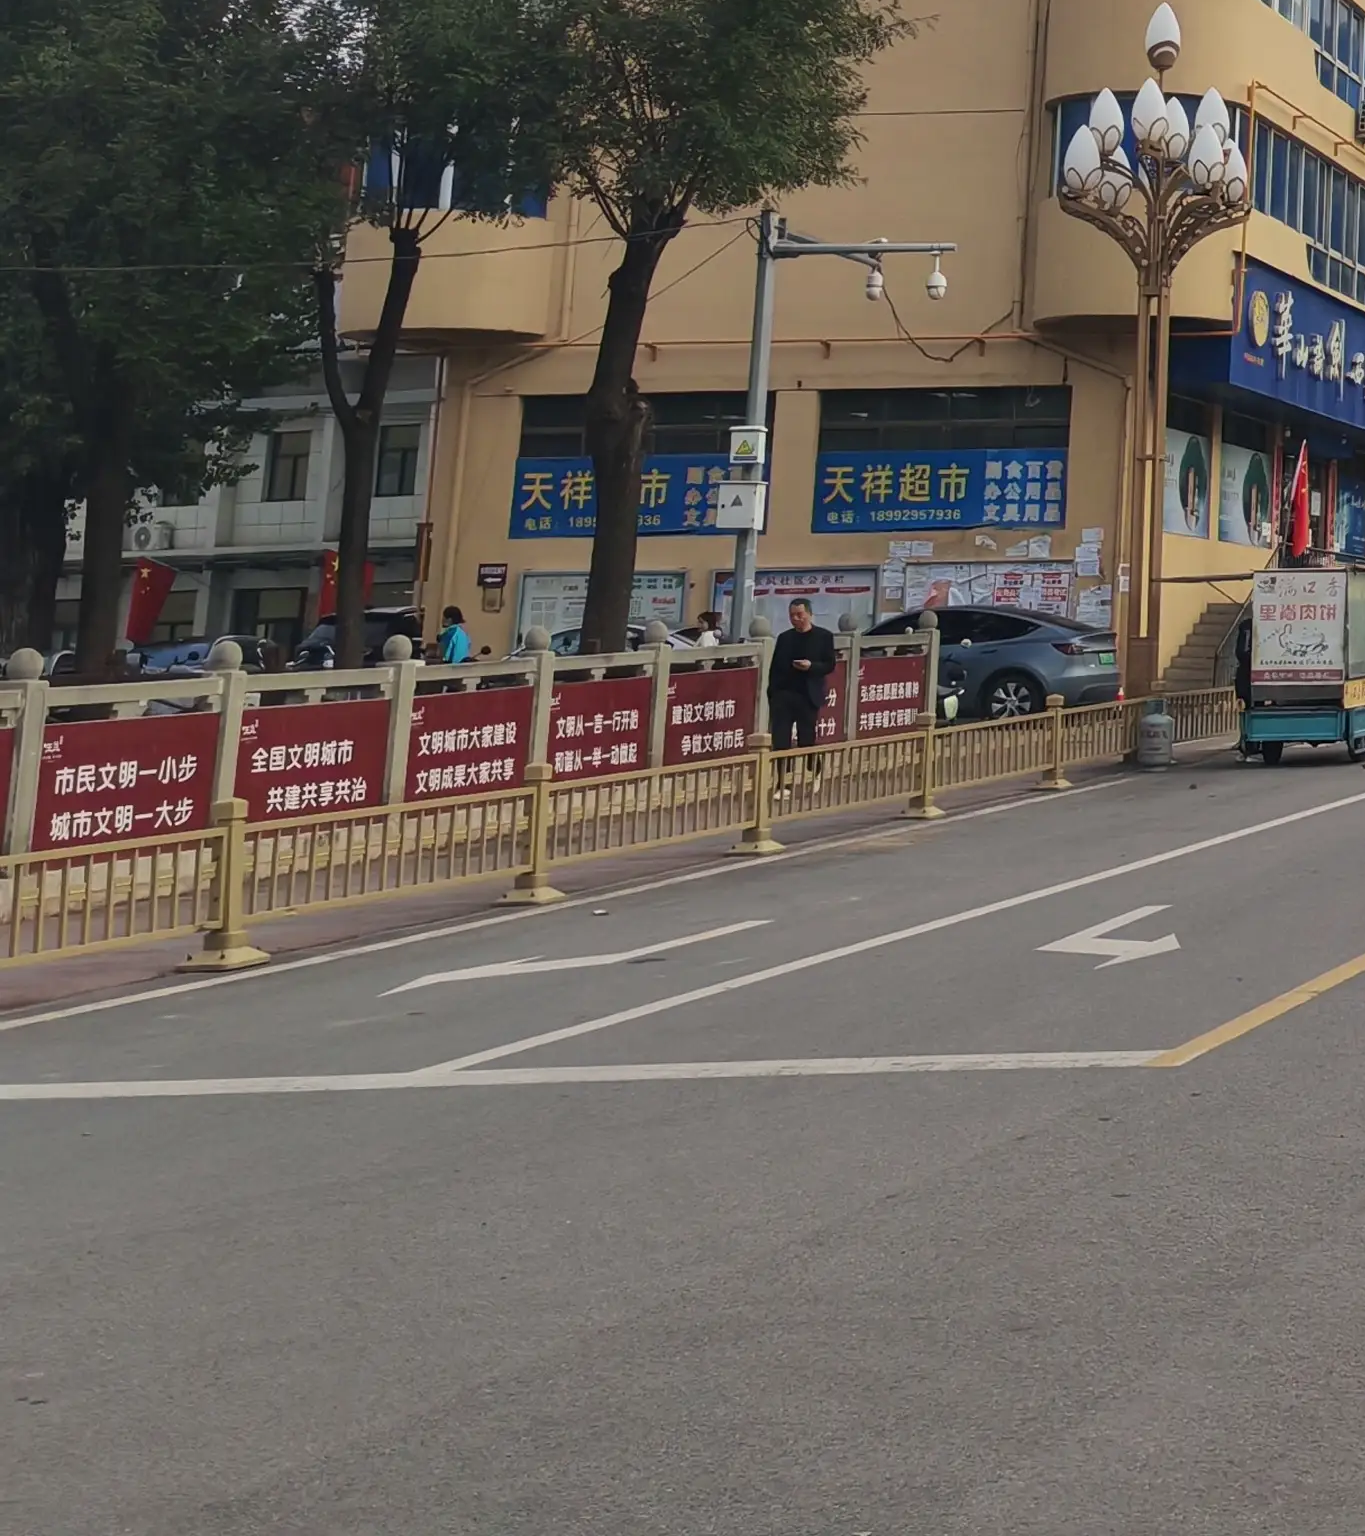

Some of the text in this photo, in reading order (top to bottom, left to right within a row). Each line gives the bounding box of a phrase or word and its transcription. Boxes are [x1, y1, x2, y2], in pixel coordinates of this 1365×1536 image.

[521, 468, 671, 511] 天祥市
[823, 462, 971, 505] 天祥超市
[869, 509, 962, 522] 18992957936
[556, 709, 639, 739] 文明从一言一行开始
[671, 699, 736, 726] 建设文明城市
[417, 721, 518, 756] 文明城市大家建设
[681, 728, 745, 756] 争做文明市民
[251, 739, 354, 774] 全国文明城市
[554, 743, 638, 773] 和谐从一举一动做起
[54, 754, 198, 796] 市民文明一小步
[414, 758, 515, 795] 文明成果大家共享
[265, 777, 368, 813] 共建共享共治
[50, 797, 194, 842] 城市文明一大步
